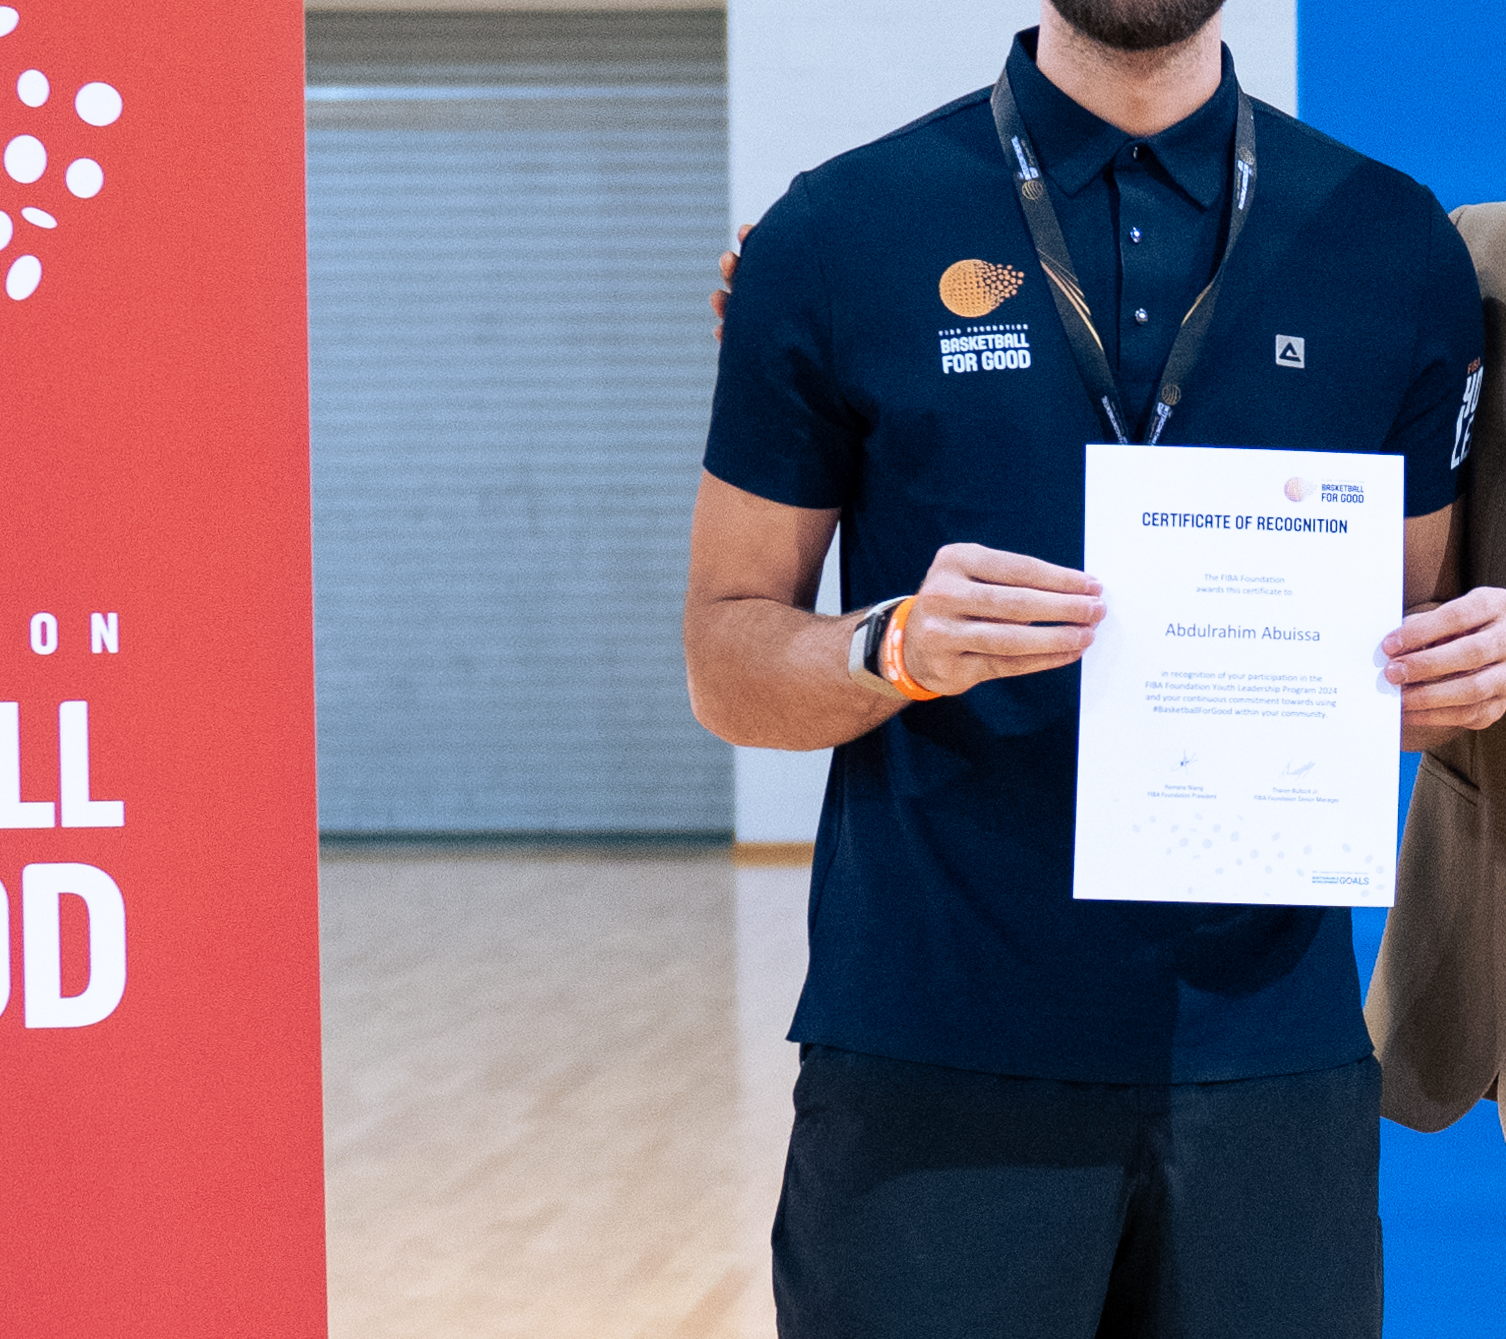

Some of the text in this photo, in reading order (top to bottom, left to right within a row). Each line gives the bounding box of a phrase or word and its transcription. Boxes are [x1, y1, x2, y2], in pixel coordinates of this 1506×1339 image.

[940, 333, 1030, 354] BASKETBALL
[941, 349, 1031, 374] FOR GOOD
[1321, 492, 1365, 504] FOR GOOD
[1142, 511, 1348, 534] CERTIFICATE OF RECOGNITION
[1204, 573, 1285, 584] The FIBA Foundation
[1242, 587, 1282, 596] certificate
[1283, 588, 1293, 596] to
[1165, 622, 1321, 642] Abdulrahim Abuissa
[1161, 670, 1169, 678] in
[1170, 671, 1216, 680] recognition
[1217, 672, 1226, 680] of
[1228, 673, 1246, 681] your
[1248, 673, 1298, 682] participation
[1145, 681, 1337, 695] FIBA Foundation Youth Leadership Program 2024
[1146, 694, 1337, 708] and your continuous commitment towards using
[1261, 709, 1280, 718] your
[1339, 876, 1370, 886] GOALS
